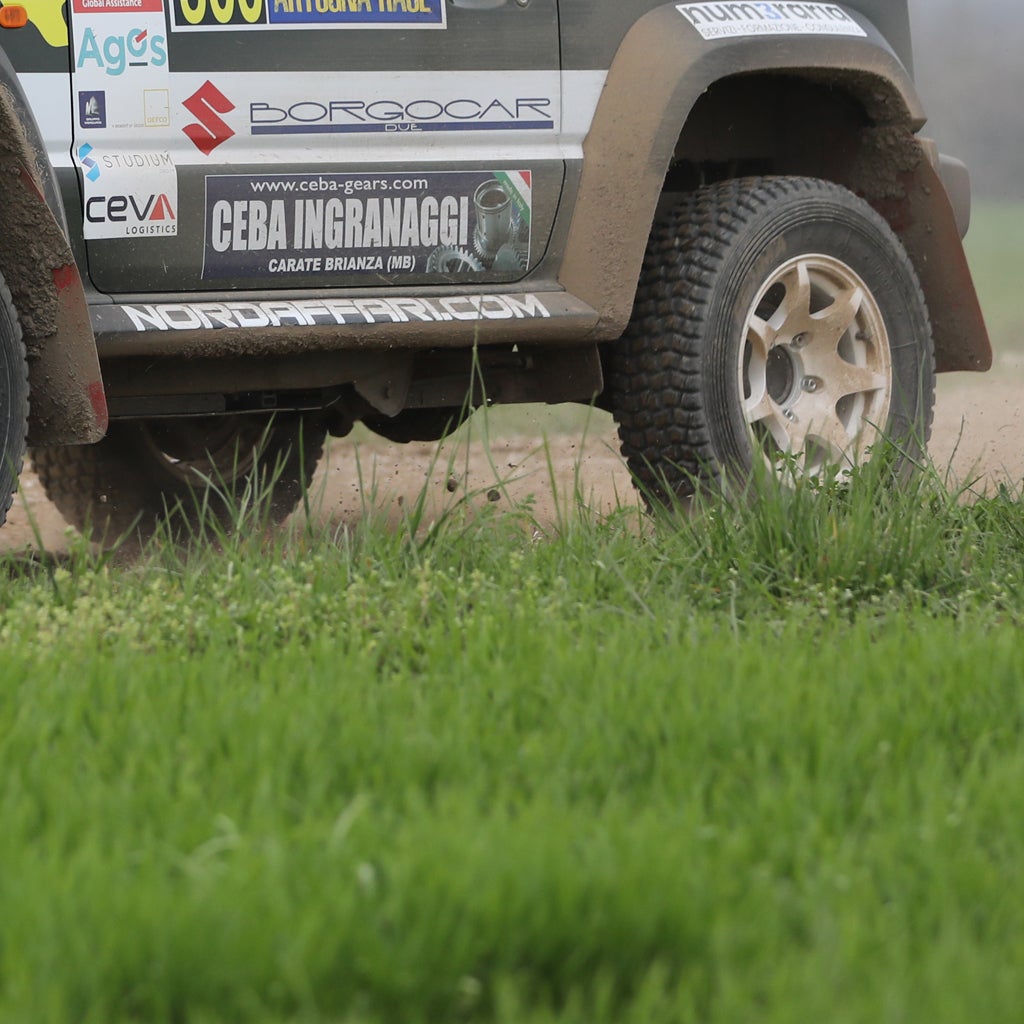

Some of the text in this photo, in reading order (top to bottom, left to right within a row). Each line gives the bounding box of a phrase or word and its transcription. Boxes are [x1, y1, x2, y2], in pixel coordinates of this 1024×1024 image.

[250, 98, 551, 123] BORGOCAR
[384, 123, 422, 131] DUE
[102, 153, 173, 169] STUDIUM
[250, 176, 429, 194] www.ceba-gears.com
[126, 225, 176, 235] LOGISTICS
[212, 199, 287, 252] CEBA
[293, 195, 469, 249] INGRANAGGI
[268, 255, 416, 273] CARATE BRIANZA (MB)
[120, 294, 552, 332] NORDAFFARI.COM
